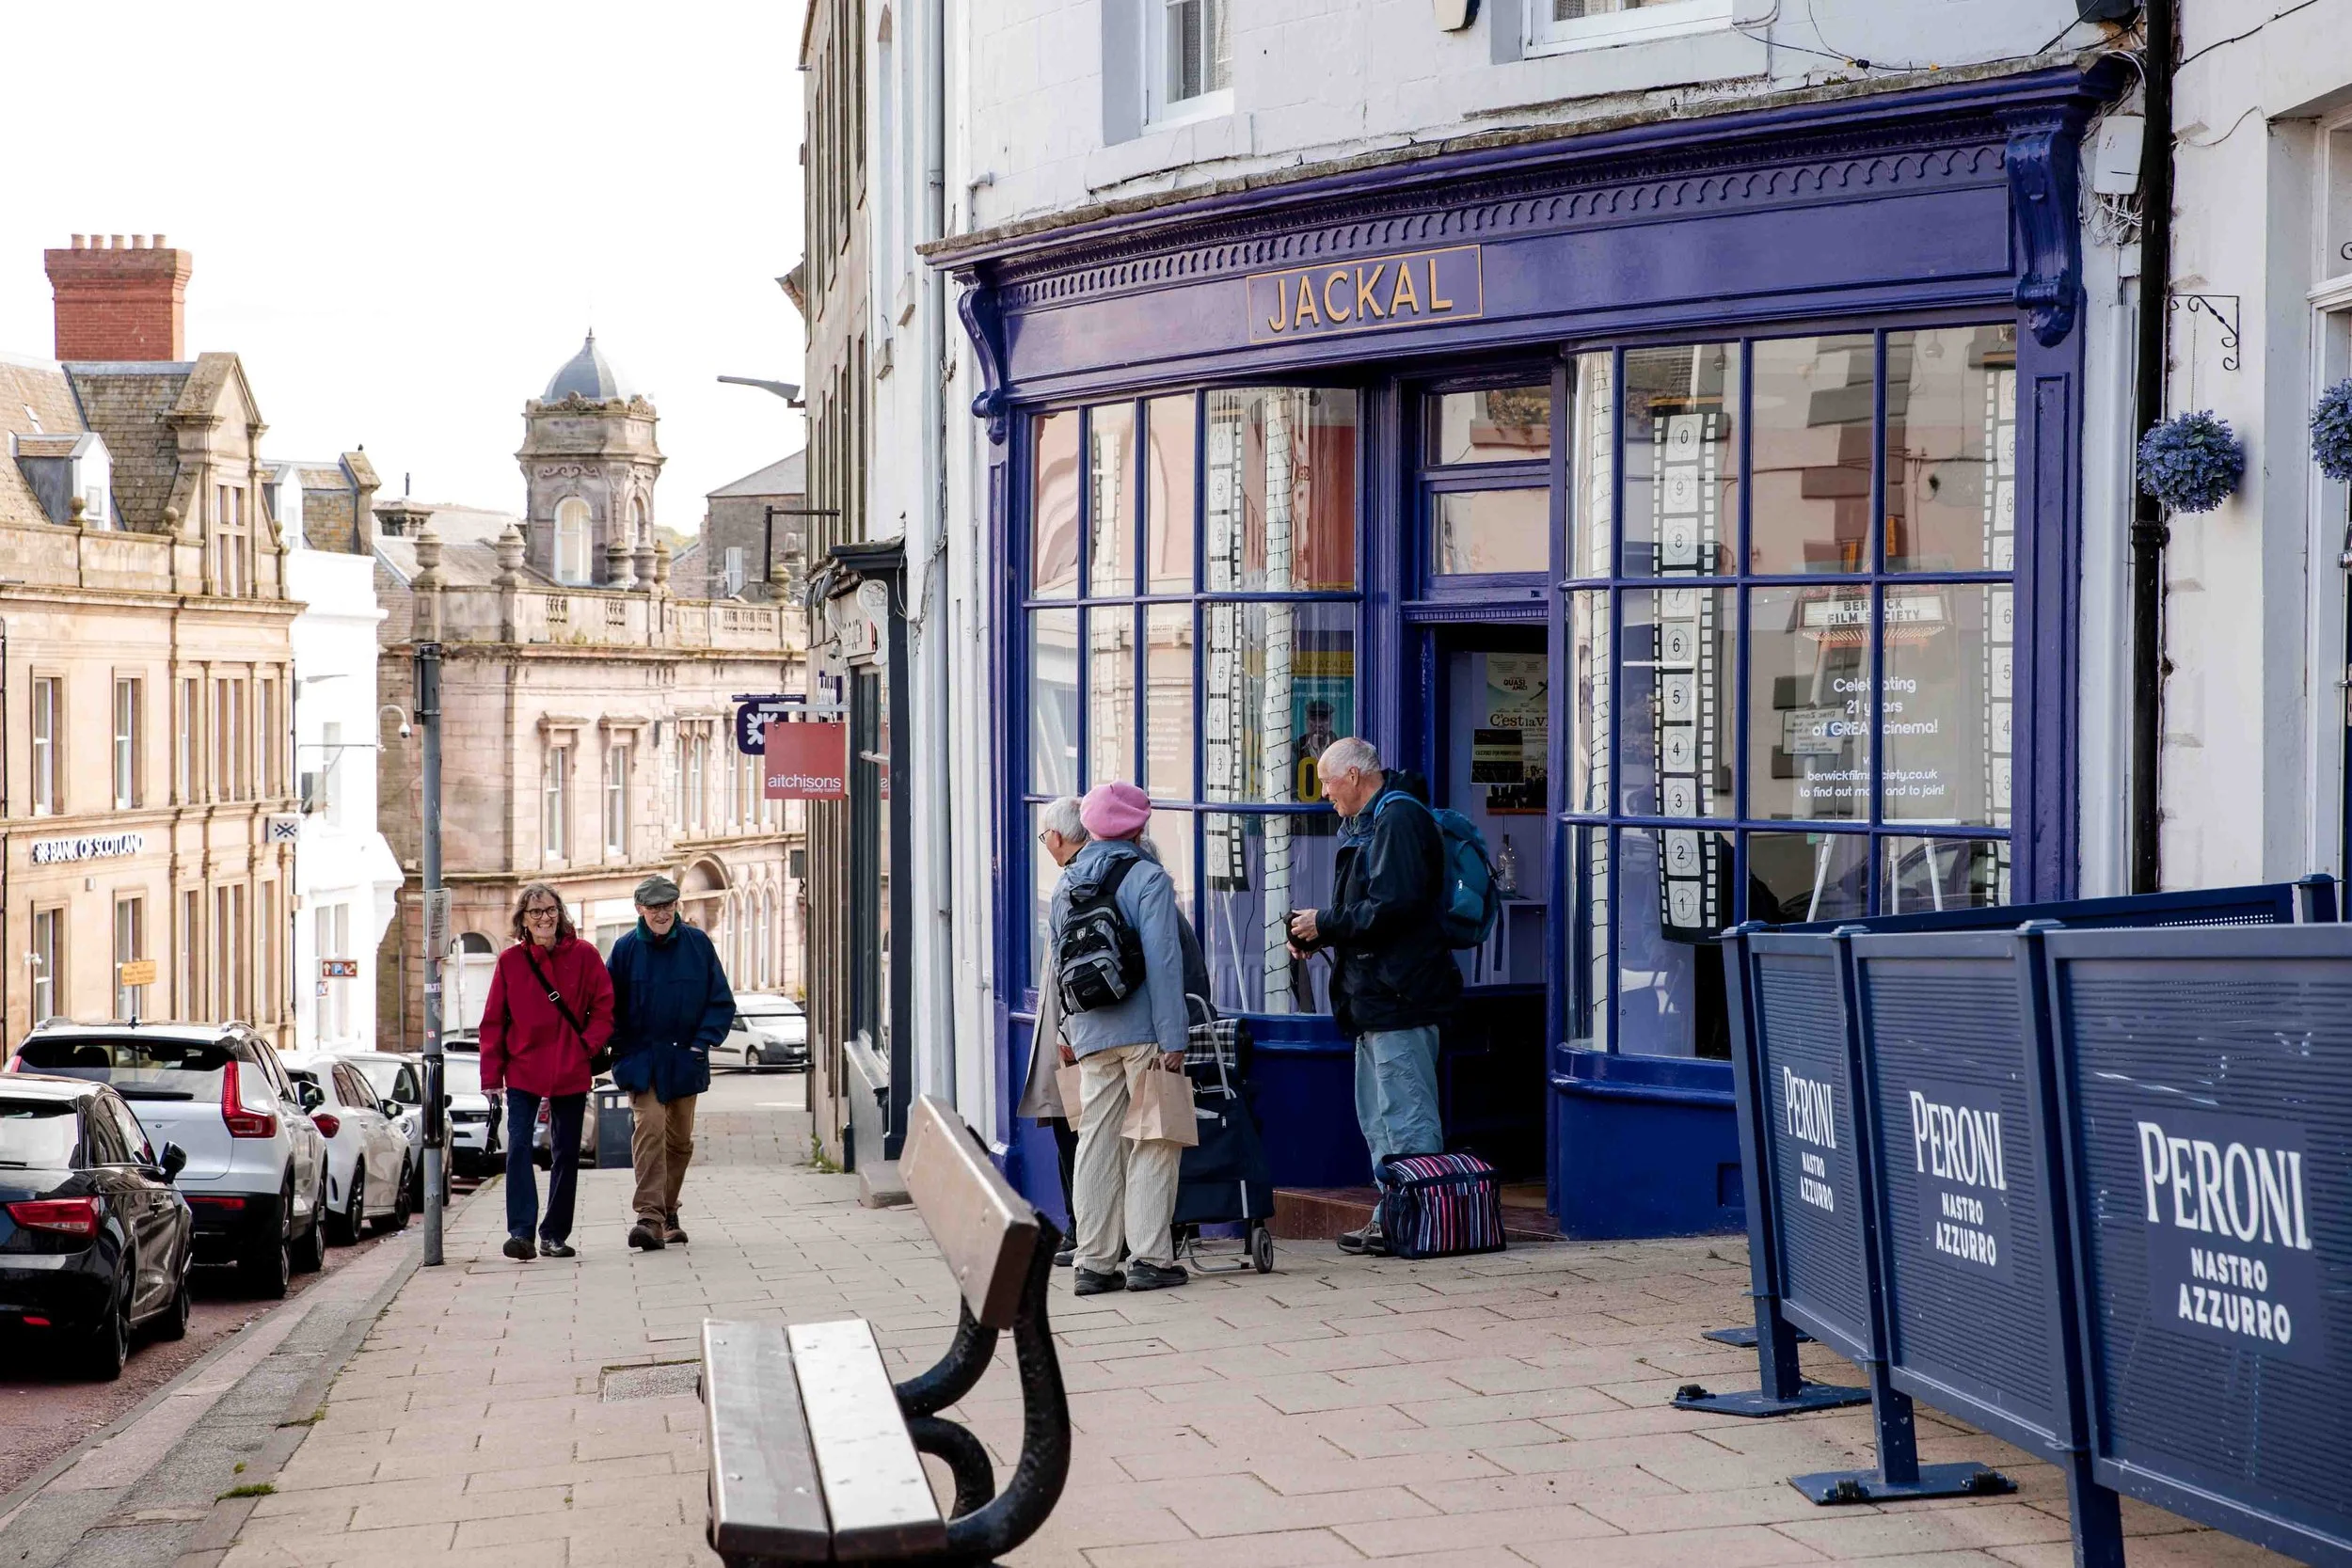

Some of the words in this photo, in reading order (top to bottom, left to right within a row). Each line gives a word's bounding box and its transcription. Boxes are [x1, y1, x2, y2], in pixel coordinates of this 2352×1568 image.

[1268, 258, 1454, 332] JACKAL
[1677, 481, 1684, 497] 9
[2006, 497, 2013, 513] 8
[1675, 532, 1683, 548] 8
[2005, 554, 2013, 569] 7
[1843, 599, 1903, 612] BERCK
[1827, 612, 1859, 624] FILM
[1865, 609, 1920, 622] SCIETY
[2003, 608, 2012, 625] 6
[1672, 637, 1681, 653] 6
[1218, 665, 1225, 680] 5
[2003, 664, 2011, 680] 5
[1833, 677, 1916, 693] Celeating
[1673, 689, 1680, 705] 5
[1846, 700, 1860, 714] 21
[1864, 701, 1903, 716] yars
[1214, 713, 1221, 727] 4
[1812, 721, 1828, 736] of
[1830, 721, 1870, 736] GREA
[1883, 719, 1939, 735] cinema!
[2002, 719, 2010, 735] 4
[1672, 741, 1681, 757] 4
[1216, 756, 1223, 772] 3
[768, 773, 842, 789] aitchisons
[1807, 768, 1938, 783] berwickfilmciety.co.uk
[2004, 774, 2011, 791] 3
[1799, 786, 1811, 798] to
[1813, 786, 1833, 797] find
[1835, 785, 1852, 797] out
[1884, 784, 1907, 797] and
[1909, 784, 1920, 796] to
[1922, 784, 1945, 798] join!
[1675, 793, 1682, 809] 3
[48, 841, 77, 863] BANK
[78, 838, 91, 860] OF
[92, 834, 144, 858] SCOTLAND
[1677, 845, 1685, 861] 2
[1679, 896, 1685, 912] 1
[1783, 1066, 1836, 1149] PERONI
[1909, 1090, 2007, 1191] PERONI
[1802, 1151, 1825, 1179] NASTRO
[2137, 1121, 2312, 1251] PERONI
[1800, 1176, 1834, 1213] AZZURRO
[1941, 1192, 1984, 1227] NASTRO
[1935, 1221, 1997, 1267] AZZURRO
[2190, 1246, 2268, 1292] NASTRO
[2178, 1282, 2292, 1345] AZZURRO
